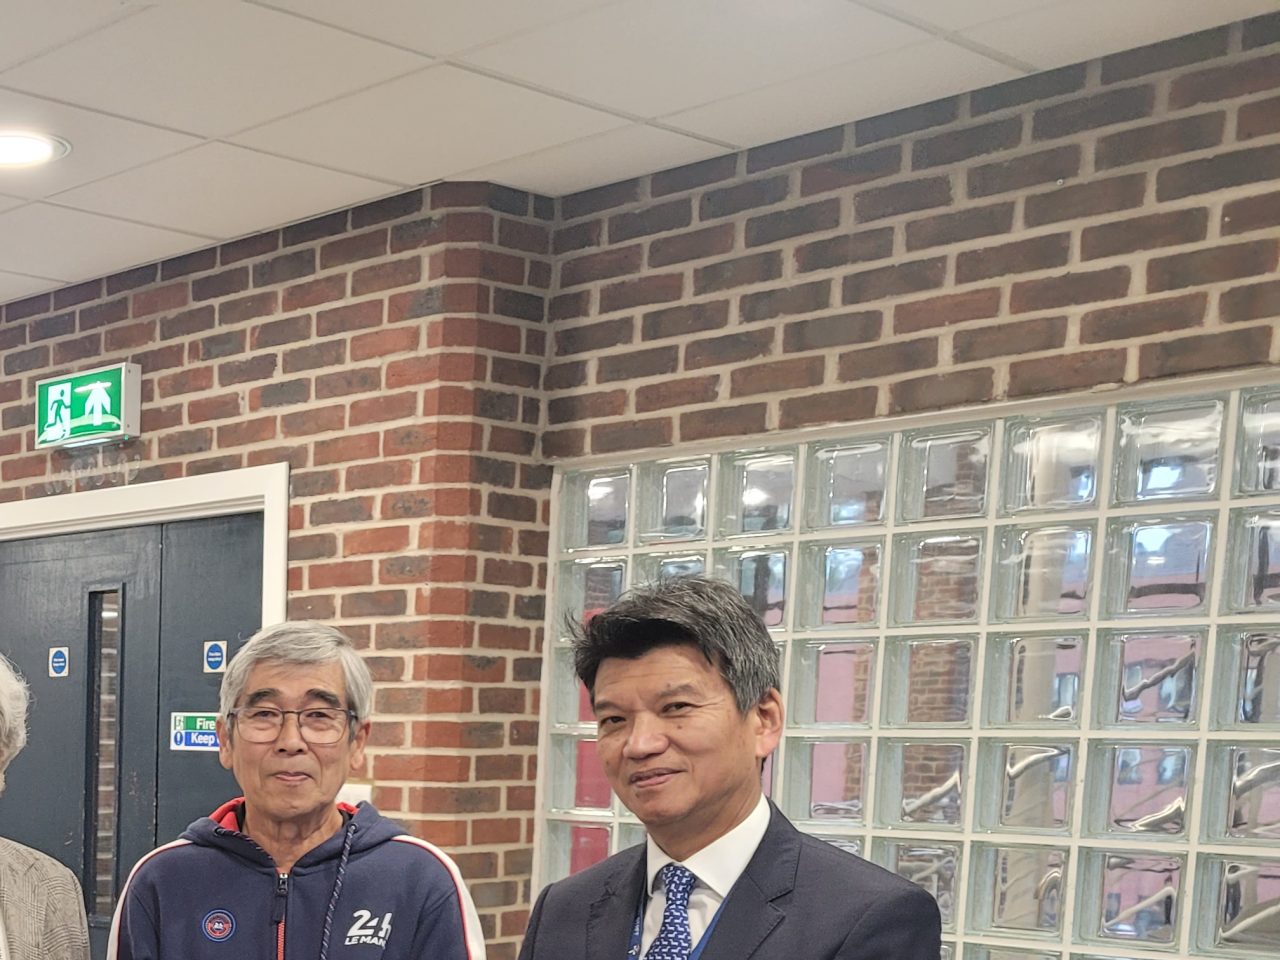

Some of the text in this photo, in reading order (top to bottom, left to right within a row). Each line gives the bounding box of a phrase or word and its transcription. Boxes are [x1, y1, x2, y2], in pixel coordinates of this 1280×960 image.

[196, 717, 216, 730] Fire
[191, 732, 215, 746] Keep
[344, 936, 360, 945] LE
